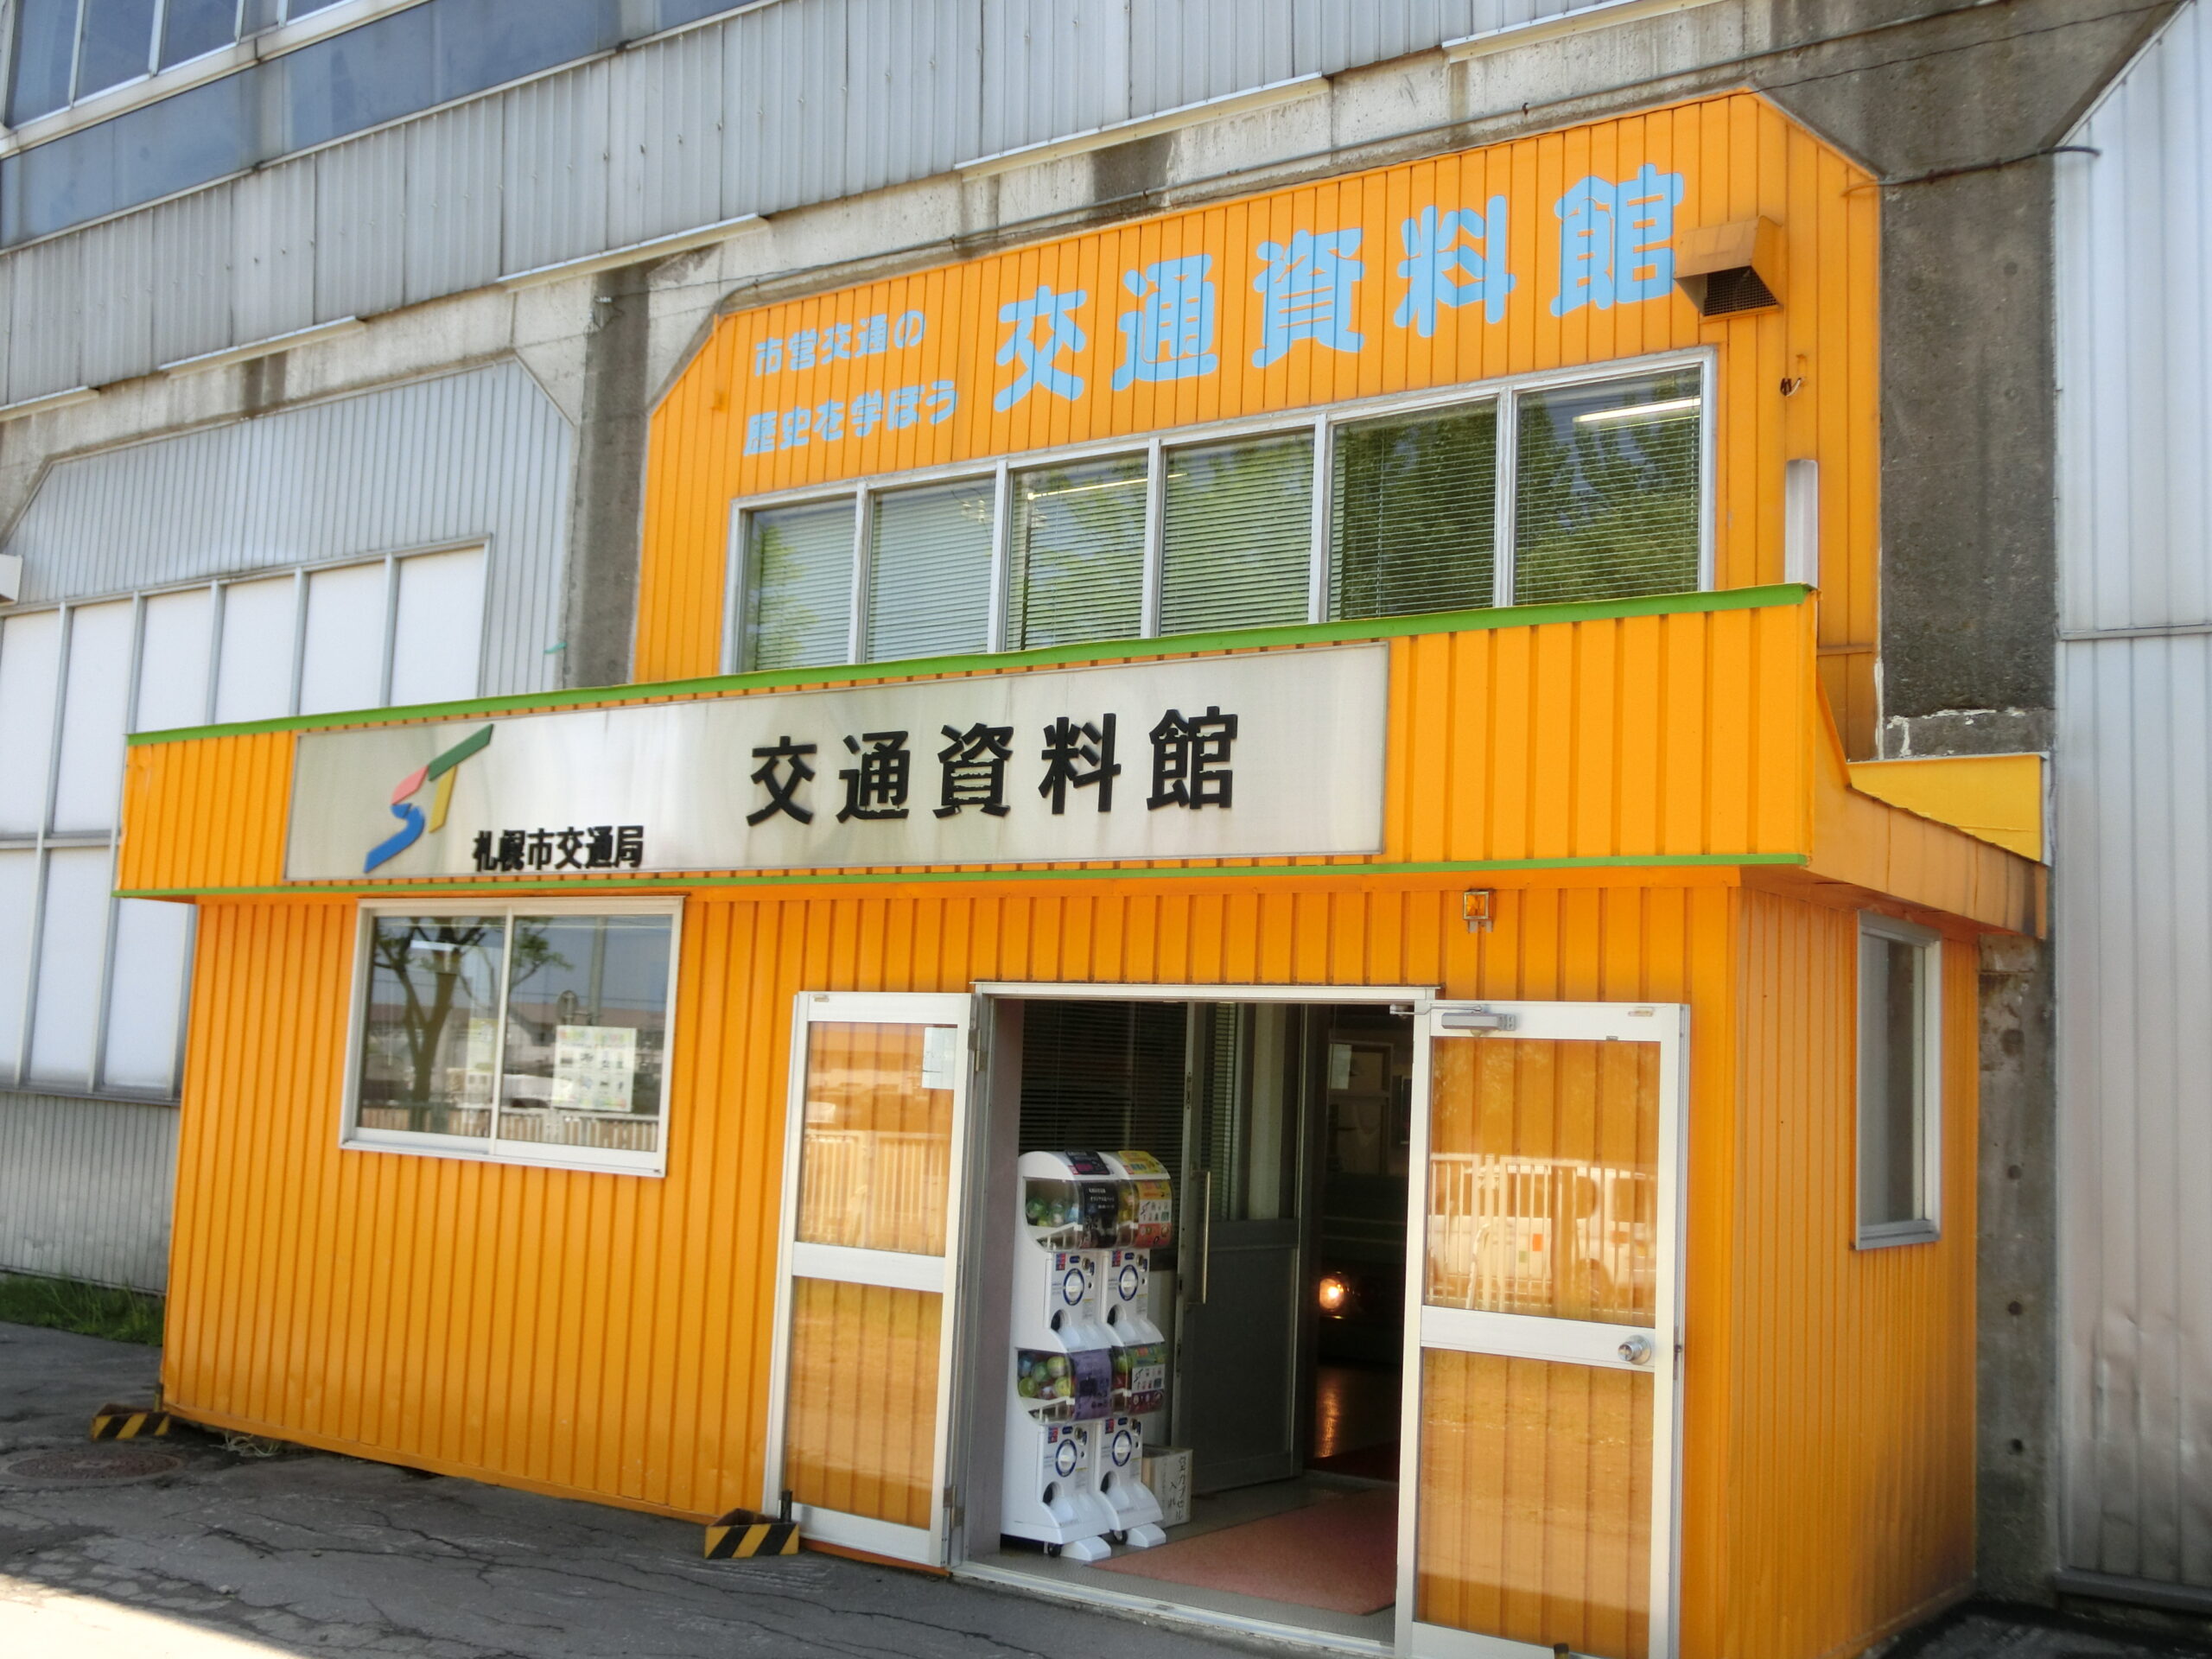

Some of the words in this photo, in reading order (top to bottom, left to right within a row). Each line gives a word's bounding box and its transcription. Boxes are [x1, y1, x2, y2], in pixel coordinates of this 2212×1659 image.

[994, 163, 1685, 412] 交通資料館
[755, 310, 925, 378] 市営交通の
[742, 379, 957, 456] 歴史を学ぼう
[746, 706, 1238, 826] 交通資料館
[473, 824, 644, 872] 札幌市交通局
